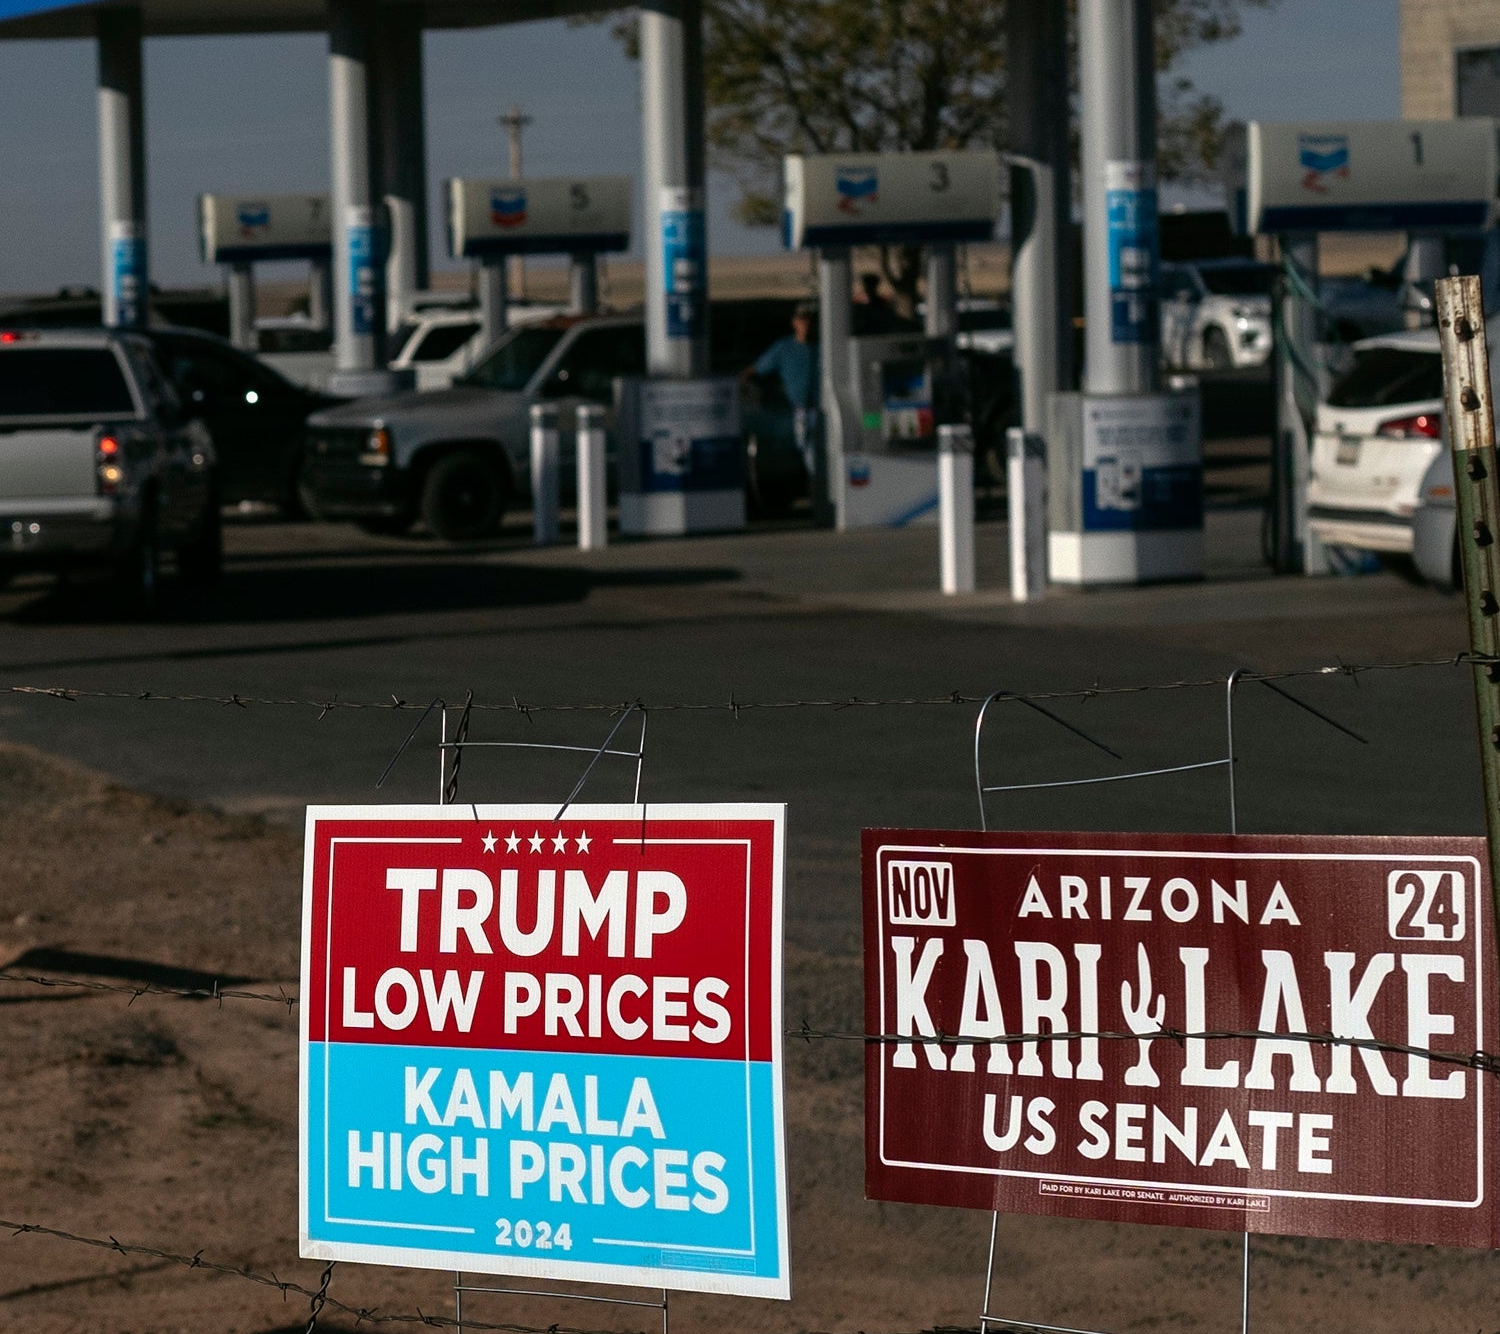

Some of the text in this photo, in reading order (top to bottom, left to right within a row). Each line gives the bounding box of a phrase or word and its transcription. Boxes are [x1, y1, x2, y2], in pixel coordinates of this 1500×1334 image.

[385, 867, 688, 959] TRUMP
[891, 864, 952, 923] NOV
[1018, 875, 1300, 927] ARIZONA
[1393, 872, 1460, 939] 24
[342, 967, 732, 1044] LOW PRICES
[891, 935, 1466, 1099] KARI LAKE
[404, 1066, 666, 1140] KAMALA
[982, 1094, 1333, 1174] US SENATE
[347, 1130, 729, 1214] HIGH PRICES
[1041, 1183, 1059, 1193] PAID
[1059, 1184, 1073, 1194] FOR
[1074, 1186, 1083, 1195] BY
[1084, 1187, 1101, 1196] KARI
[1102, 1188, 1120, 1197] LAKE
[1122, 1189, 1136, 1198] FOR
[1168, 1194, 1214, 1204] AUTHORIZED
[1215, 1196, 1225, 1205] BY
[1227, 1197, 1245, 1206] KARI
[495, 1217, 573, 1251] 2024
